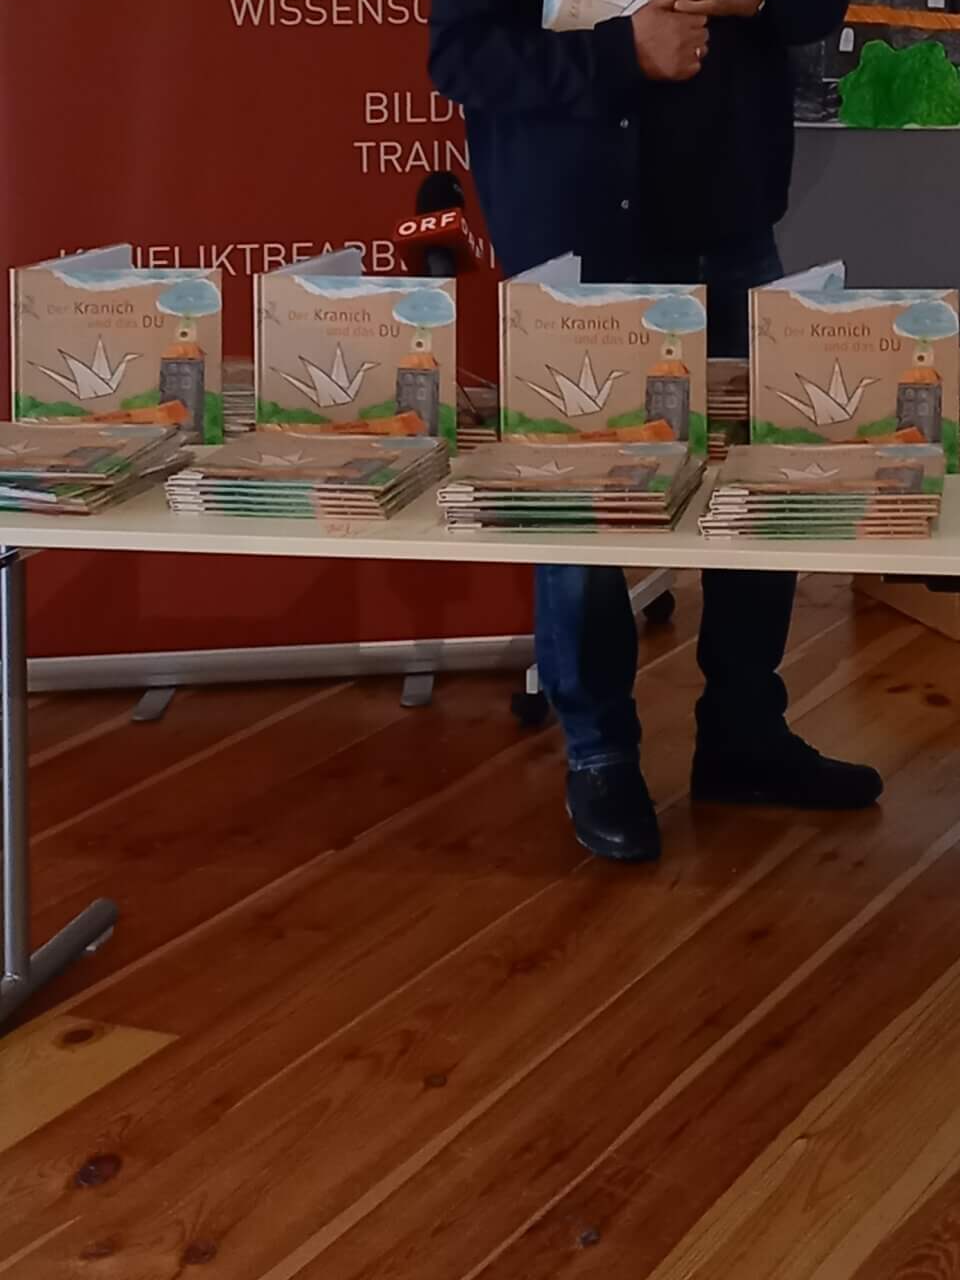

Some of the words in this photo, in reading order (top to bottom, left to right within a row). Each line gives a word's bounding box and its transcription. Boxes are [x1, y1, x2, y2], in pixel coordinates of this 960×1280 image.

[398, 211, 457, 236] ORF
[74, 301, 134, 314] Kranich
[313, 307, 371, 322] Kranich
[142, 314, 165, 329] DU
[560, 316, 620, 330] Kranich
[378, 323, 401, 338] DU
[810, 322, 871, 338] Kranich
[628, 331, 650, 346] DU
[879, 338, 902, 353] DU
